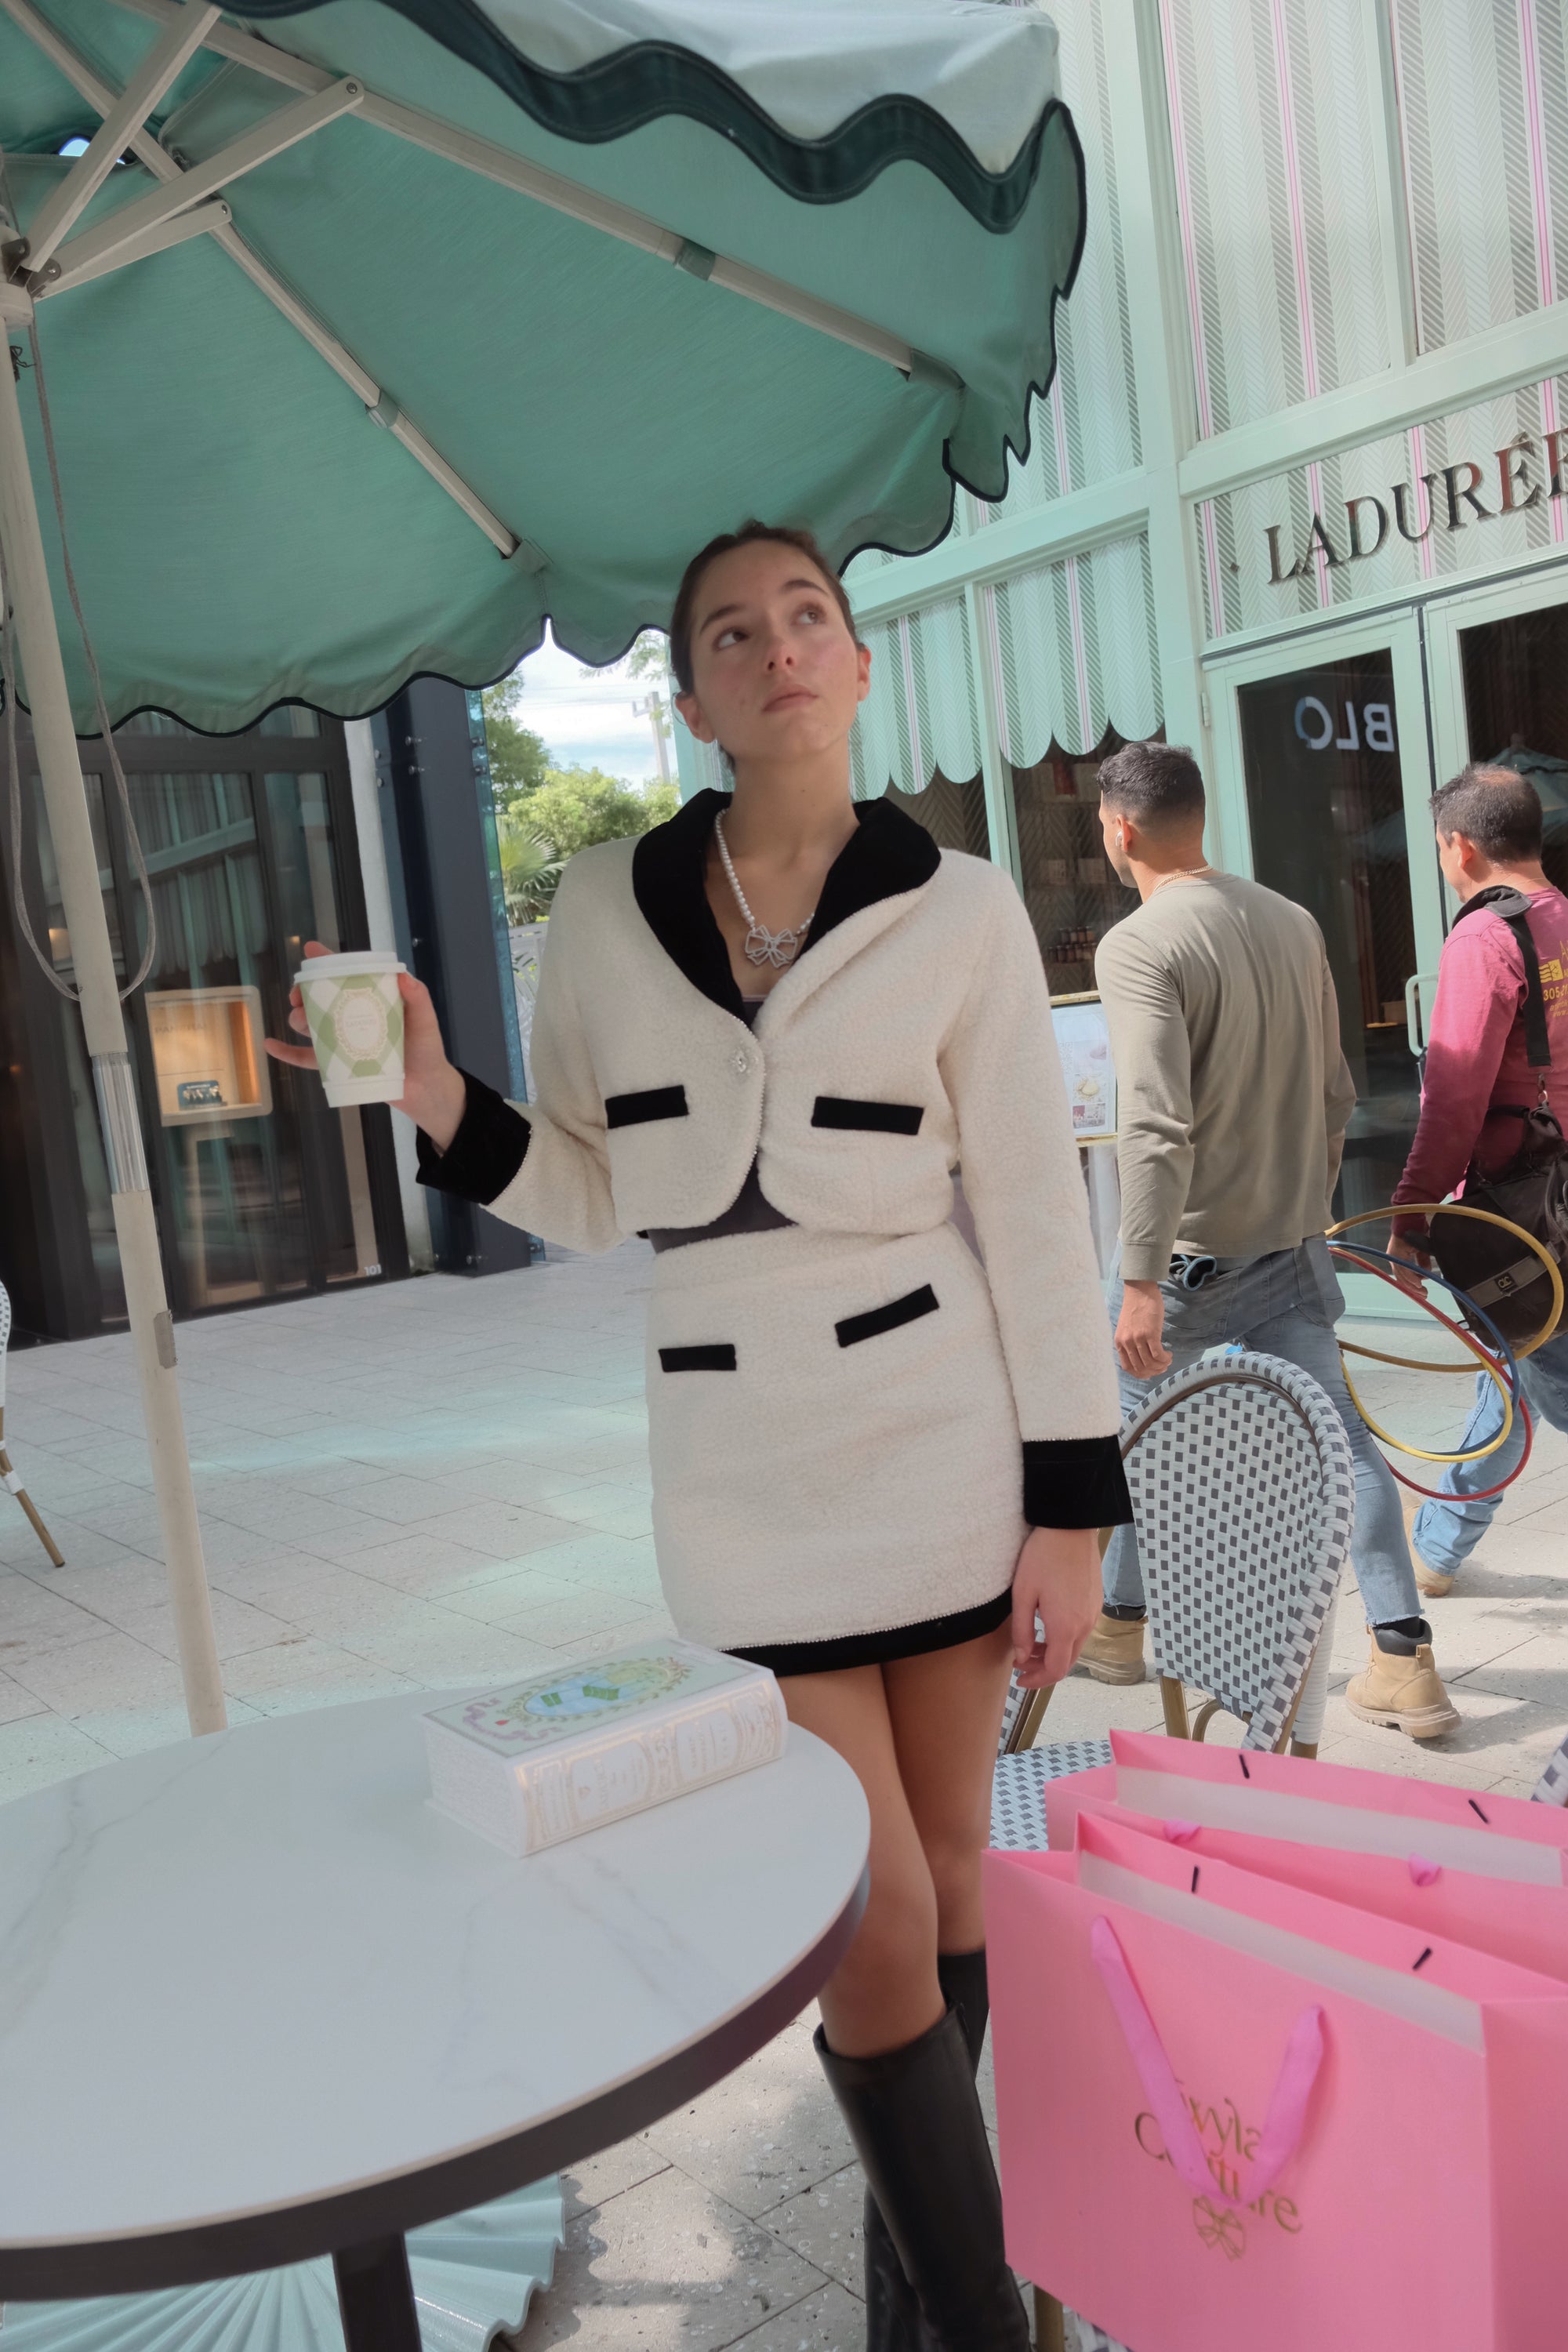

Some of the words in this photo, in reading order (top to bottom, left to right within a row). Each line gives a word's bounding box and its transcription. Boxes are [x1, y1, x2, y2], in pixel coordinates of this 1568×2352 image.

[364, 1265, 382, 1276] 101
[1174, 2077, 1262, 2161] wyla
[1134, 2111, 1303, 2234] Cture
